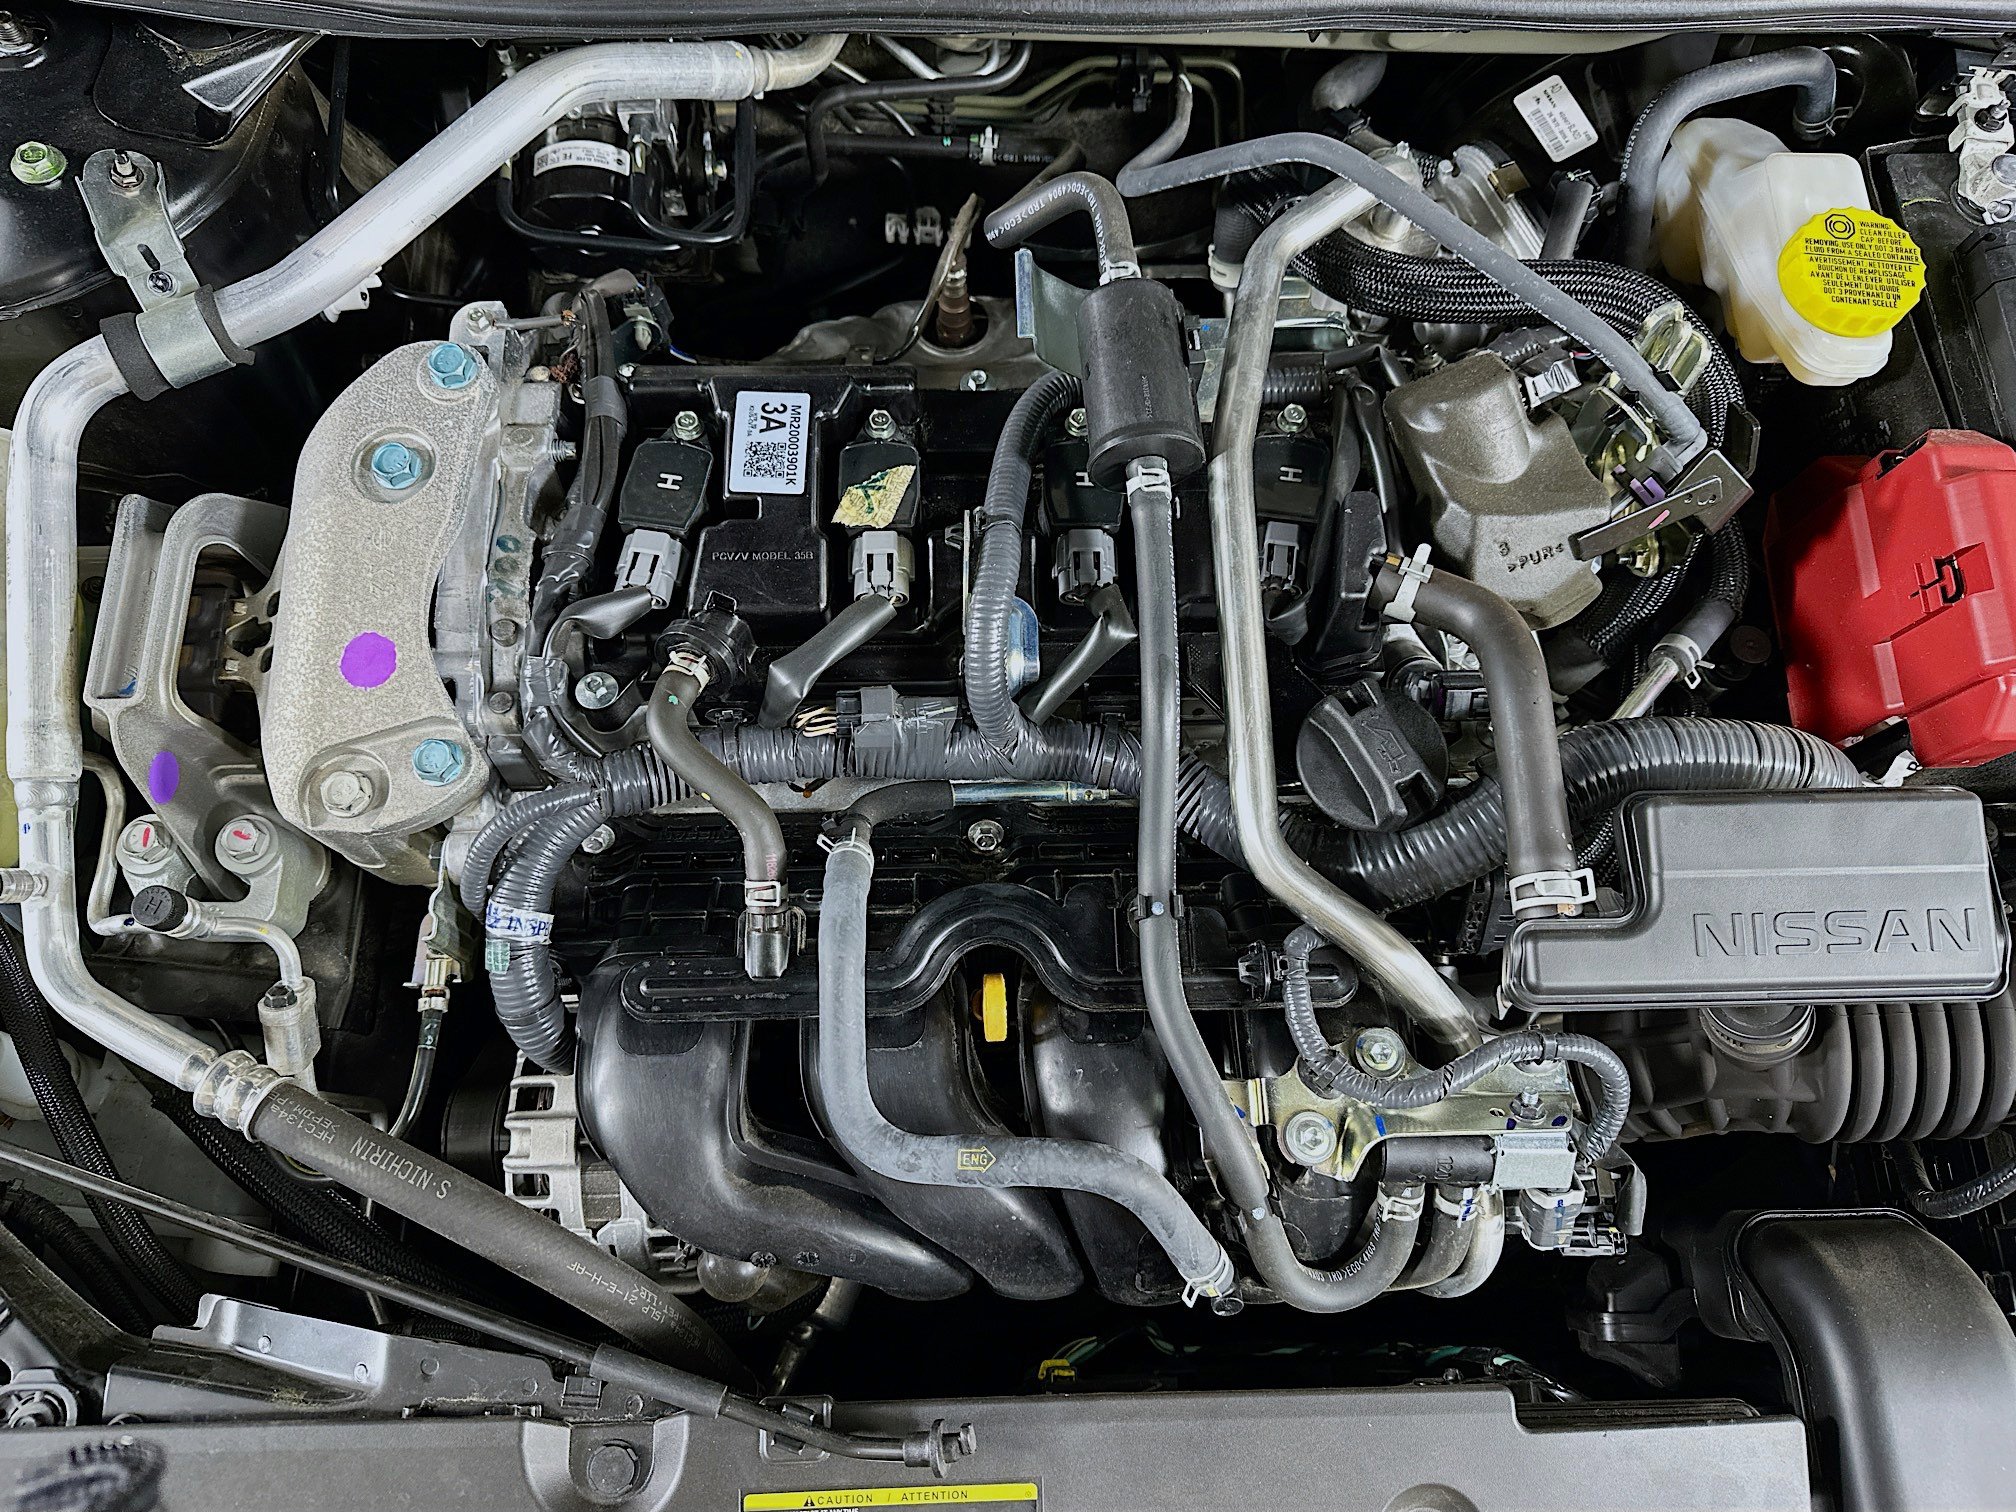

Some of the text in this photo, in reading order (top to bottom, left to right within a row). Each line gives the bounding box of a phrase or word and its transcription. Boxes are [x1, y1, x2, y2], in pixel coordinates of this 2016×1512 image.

[1860, 229, 1906, 239] CLEAN FILLER
[1878, 237, 1901, 246] BEFORE
[1855, 250, 1881, 259] SEALED
[1856, 243, 1872, 251] ONLY
[1895, 247, 1917, 255] BRAKE
[1818, 264, 1847, 272] BOUCHON
[1859, 268, 1906, 279] REMPLISSAGE
[1869, 262, 1903, 271] NETTOYER
[1811, 271, 1834, 279] AVANT
[1887, 278, 1915, 287] UTILISER
[1823, 279, 1862, 289] SEULEMENT
[1875, 284, 1899, 293] LIQUIDE
[1832, 295, 1870, 305] CONTENANT
[1845, 289, 1884, 299] PROVENANT
[758, 402, 788, 434] 3A
[785, 404, 802, 486] MR20003901K
[1693, 907, 1982, 956] NISSAN
[962, 1153, 988, 1165] ENG
[817, 1493, 873, 1505] CAUTION
[901, 1490, 968, 1502] ATTENTION
